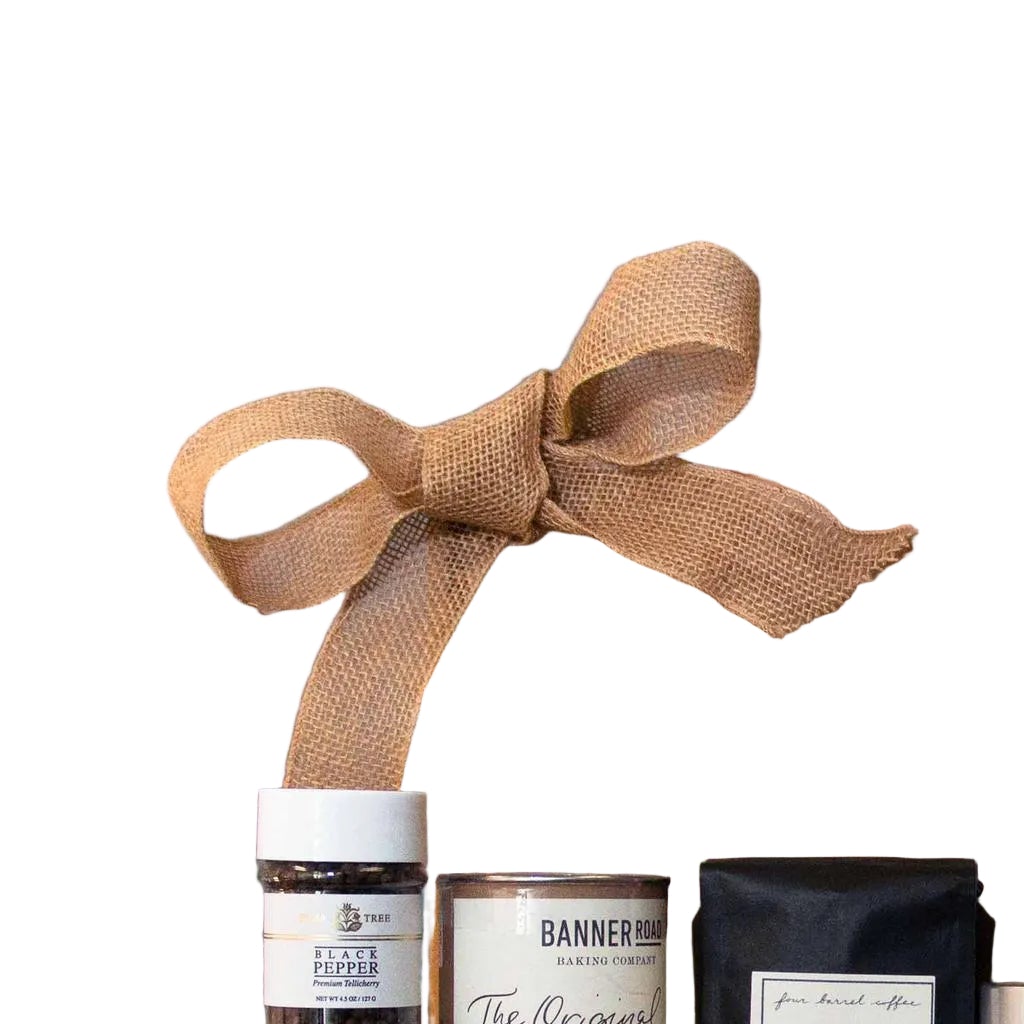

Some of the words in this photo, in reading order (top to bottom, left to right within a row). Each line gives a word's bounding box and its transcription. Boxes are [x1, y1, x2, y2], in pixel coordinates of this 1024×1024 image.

[363, 914, 391, 923] TREE
[541, 919, 632, 947] BANNER
[635, 919, 662, 940] ROAD
[314, 950, 378, 959] BLACK
[556, 956, 608, 966] BAKING
[612, 955, 657, 965] COMPANY
[313, 961, 379, 974] PEPPER
[312, 979, 342, 987] Premium
[344, 979, 380, 988] Tellicherry
[774, 992, 809, 1011] four
[816, 992, 865, 1006] barrel
[872, 994, 921, 1011] coffee
